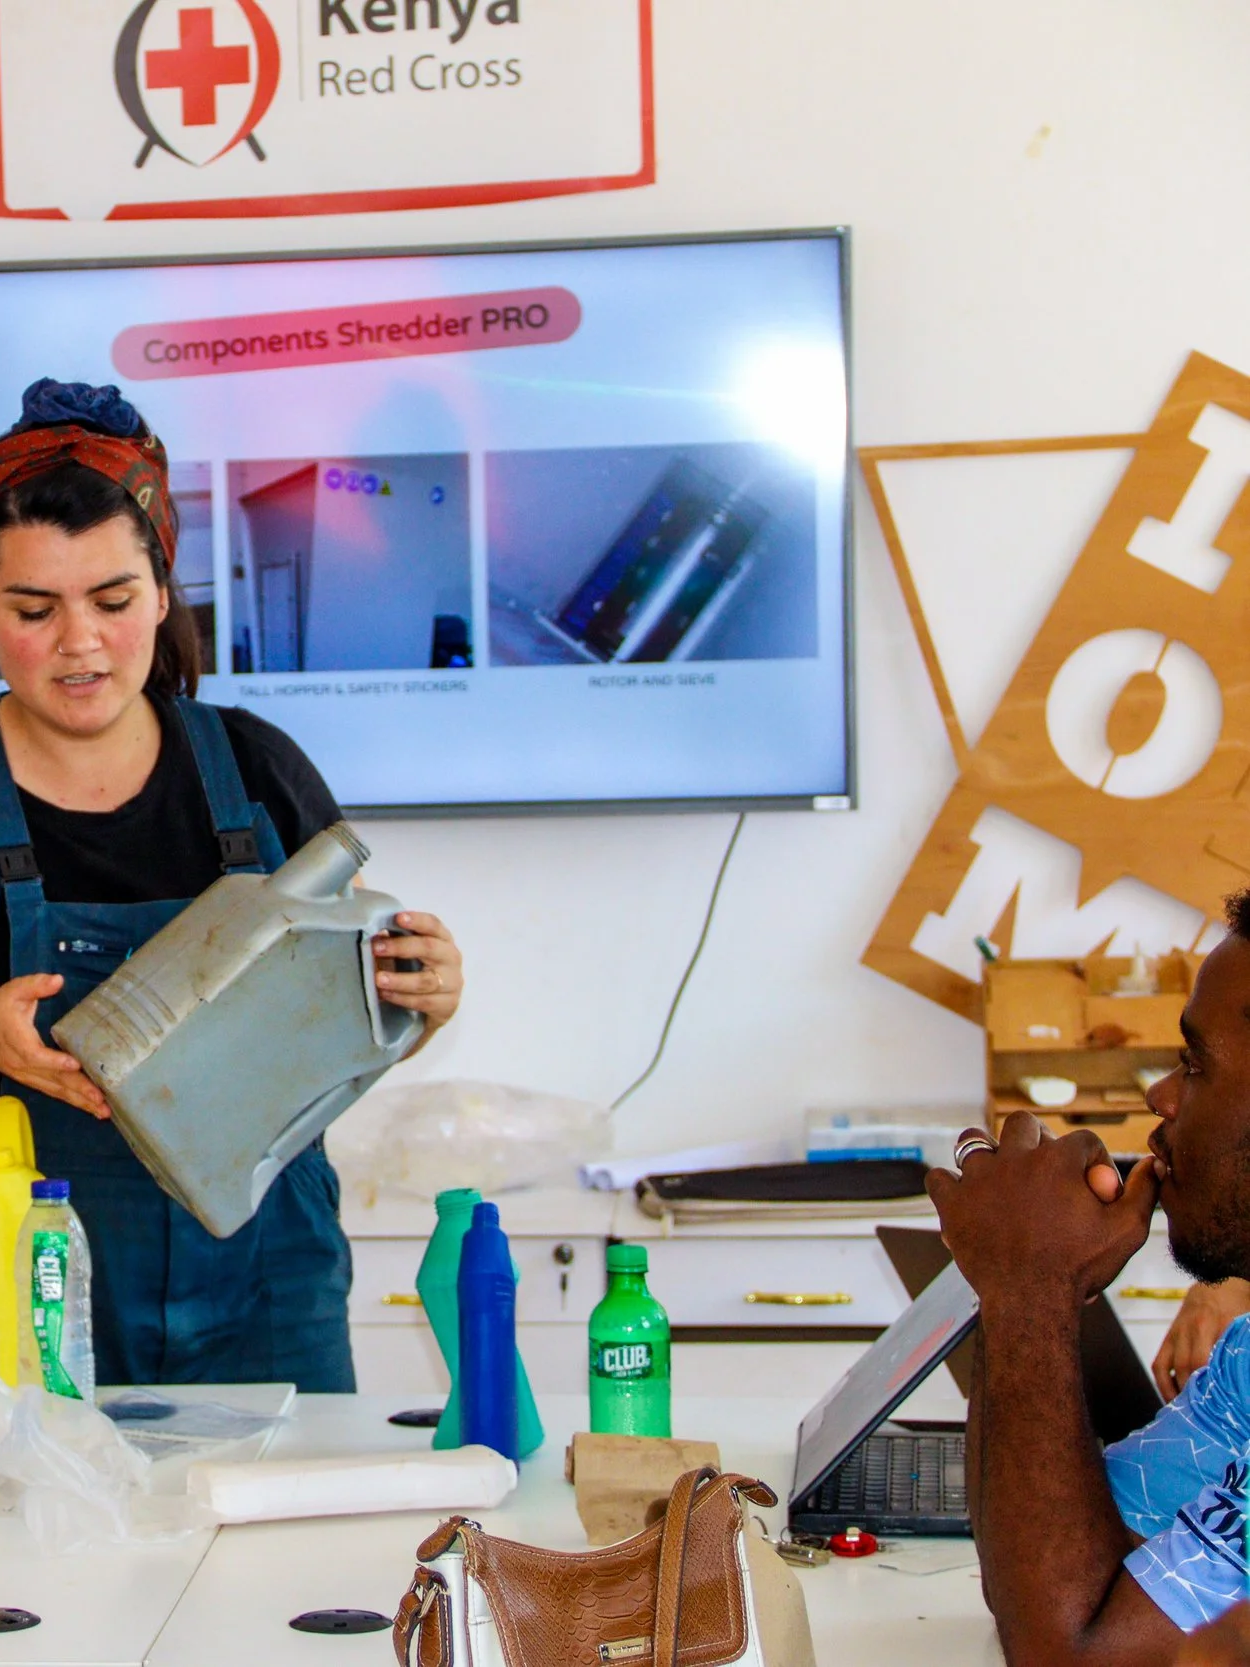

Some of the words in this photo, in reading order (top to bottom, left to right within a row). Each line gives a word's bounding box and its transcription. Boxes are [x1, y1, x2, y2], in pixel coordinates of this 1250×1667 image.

[320, 0, 519, 44] Kenya
[319, 55, 395, 97] Red
[410, 54, 522, 91] Cross
[144, 329, 329, 364] Components
[337, 313, 473, 347] Shredder
[481, 303, 549, 333] PRO
[239, 685, 271, 698] TALL
[274, 684, 332, 697] HOPPER
[349, 682, 399, 695] SAFETY
[403, 679, 469, 693] STICKERS
[588, 675, 638, 688] ROTOR
[642, 674, 673, 687] AND
[676, 672, 715, 686] SIEVE
[604, 1345, 648, 1372] CLUB
